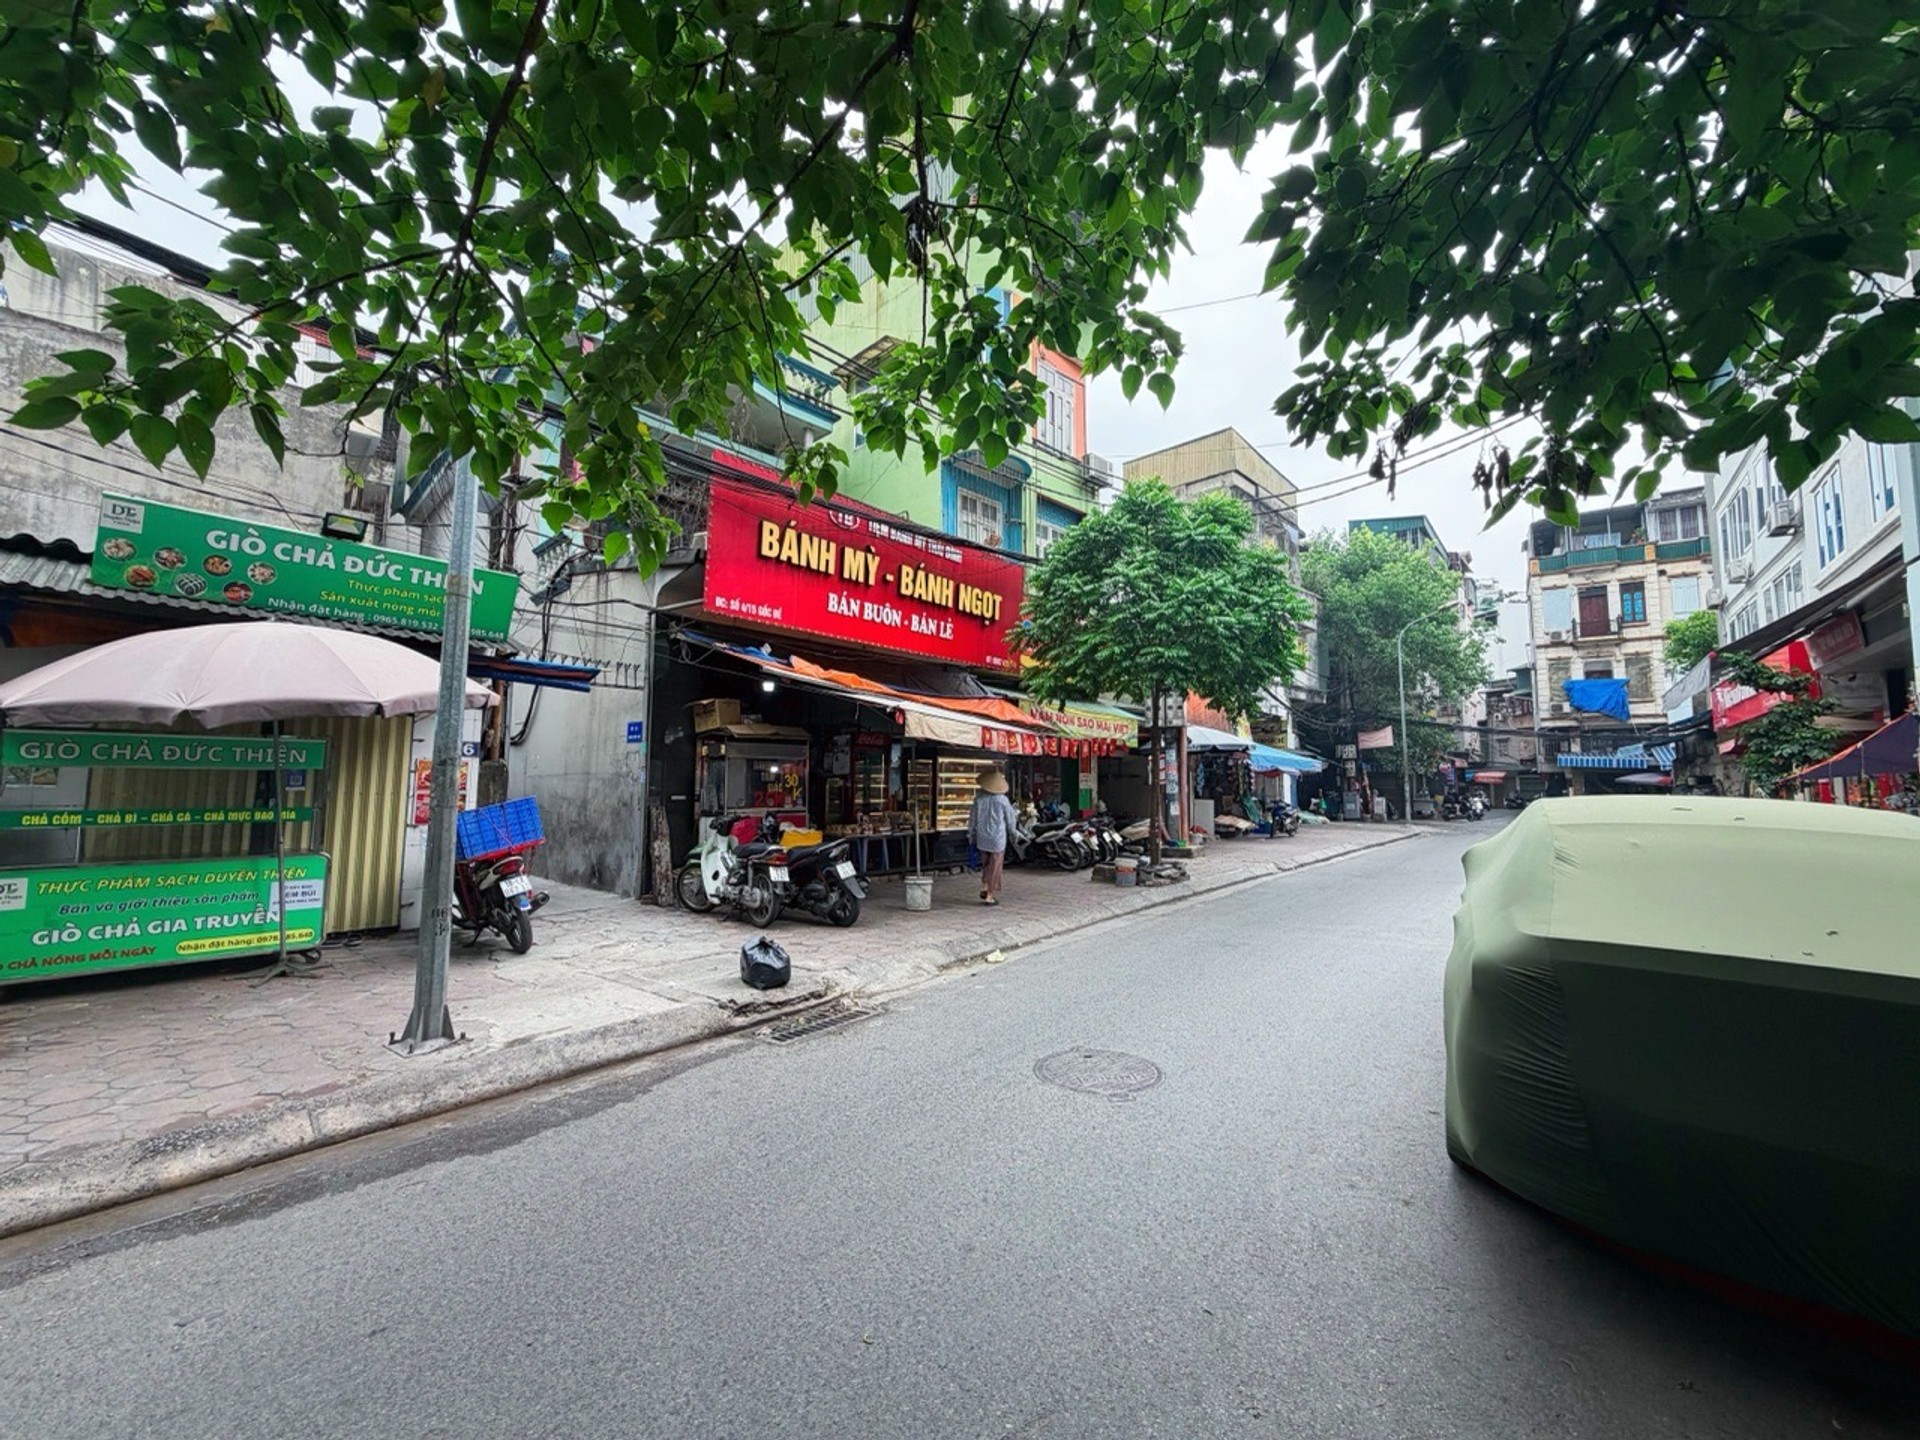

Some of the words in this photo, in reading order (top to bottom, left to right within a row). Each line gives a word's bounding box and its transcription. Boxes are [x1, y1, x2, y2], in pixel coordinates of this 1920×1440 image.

[206, 527, 267, 556] GIÒ
[273, 542, 336, 569] CHẢ
[343, 554, 404, 581] ĐỨC
[410, 567, 485, 596] THIN
[761, 519, 836, 575] BÁNH
[843, 546, 881, 587] MỲ
[900, 562, 955, 609] BÁNH
[958, 582, 1003, 626] NGỌT
[320, 588, 345, 604] Sản
[350, 594, 379, 608] xuất
[382, 600, 414, 615] nóng
[349, 579, 380, 594] Thực
[384, 587, 420, 600] phẩm
[268, 597, 305, 612] Nhận
[308, 603, 330, 615] đặt
[333, 605, 365, 621] hàng
[828, 591, 861, 618] BÁN
[863, 602, 903, 629] BUÔN
[910, 612, 939, 636] BÁN
[939, 617, 954, 640] LẺ
[19, 738, 81, 760] GIÒ
[91, 739, 153, 761] CHẢ
[162, 742, 223, 762] ĐỨC
[21, 812, 48, 826] CHẢ
[52, 811, 82, 825] CỐM
[97, 811, 121, 824] CHẢ
[150, 810, 174, 823] CHẢ
[203, 808, 225, 821] CHẢ
[228, 809, 252, 822] MỰC
[38, 879, 92, 896] THỰC
[97, 871, 151, 891] PHẨM
[156, 873, 199, 890] SẠCH
[204, 867, 258, 885] DUYÊN
[118, 897, 148, 913] giới
[152, 894, 190, 909] thiệu
[194, 893, 218, 904] sản
[221, 889, 260, 906] phẩm
[32, 922, 82, 946] GIÒ
[88, 916, 141, 941] CHẢ
[147, 917, 188, 935] GIA
[194, 901, 280, 931] TRUYỀN
[178, 940, 207, 952] Nhận
[208, 938, 226, 950] đặt
[227, 936, 254, 949] hàng:
[8, 956, 38, 970] CHẢ
[42, 951, 86, 967] NÓNG
[120, 945, 157, 960] NGÀY
